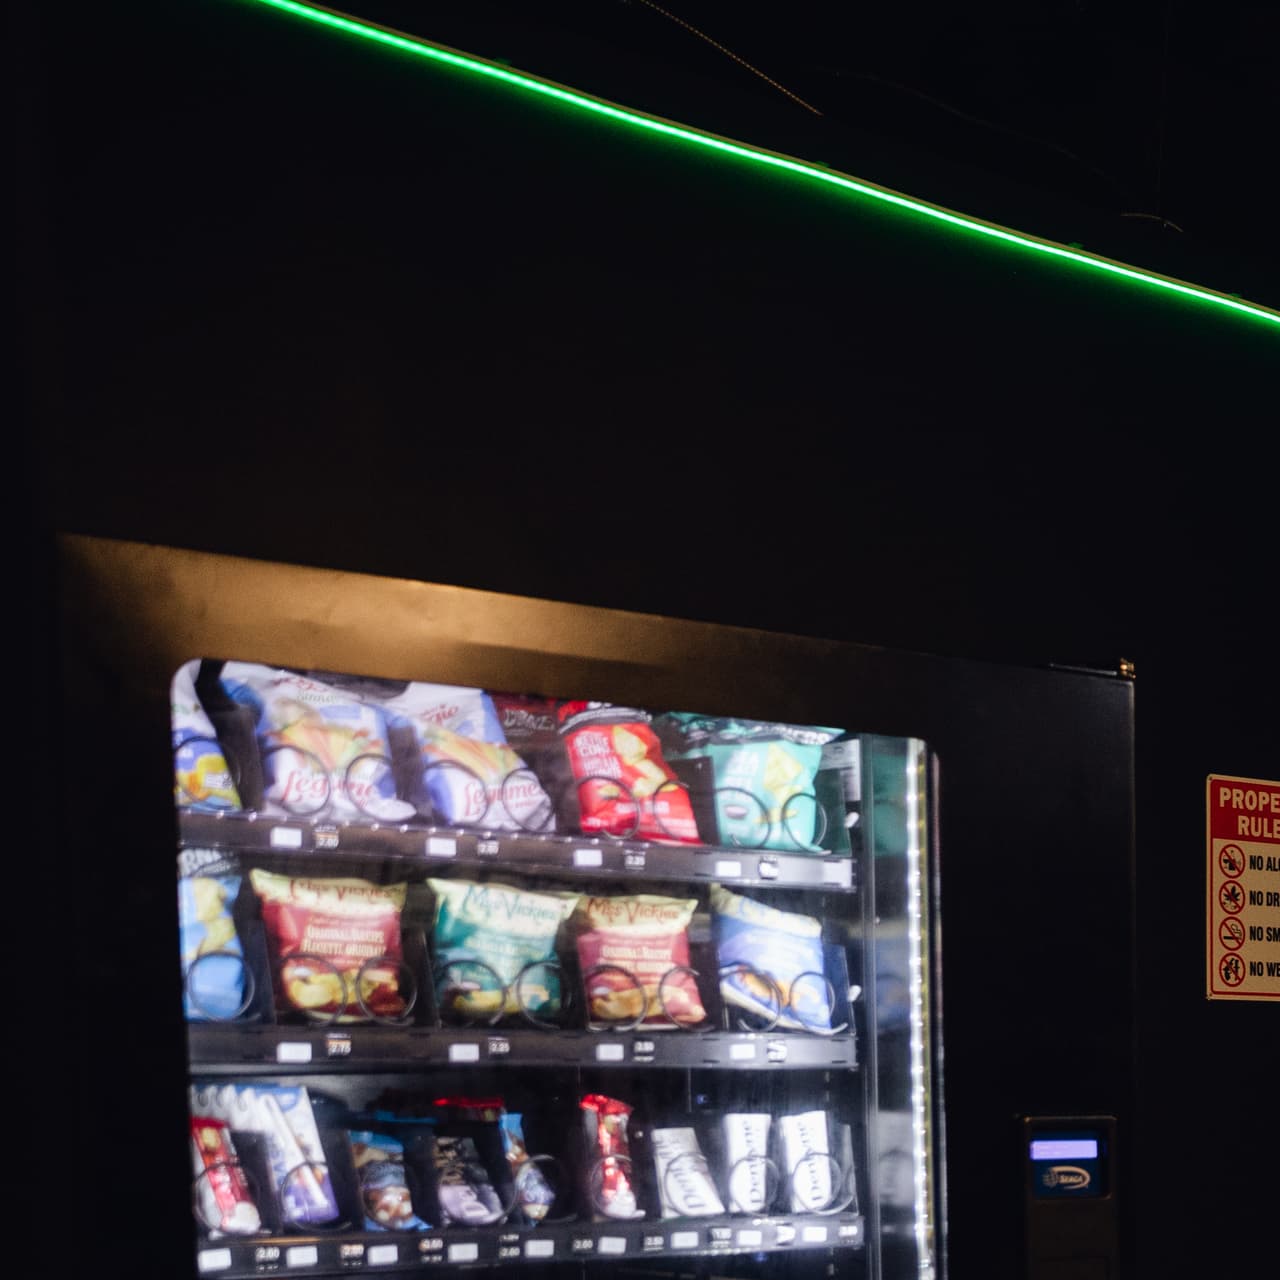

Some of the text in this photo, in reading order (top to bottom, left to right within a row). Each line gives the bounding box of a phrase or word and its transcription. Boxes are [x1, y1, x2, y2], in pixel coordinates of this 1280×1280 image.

[1249, 855, 1264, 871] NO
[1249, 890, 1264, 906] NO
[1249, 926, 1264, 942] NO
[1249, 961, 1264, 977] NO
